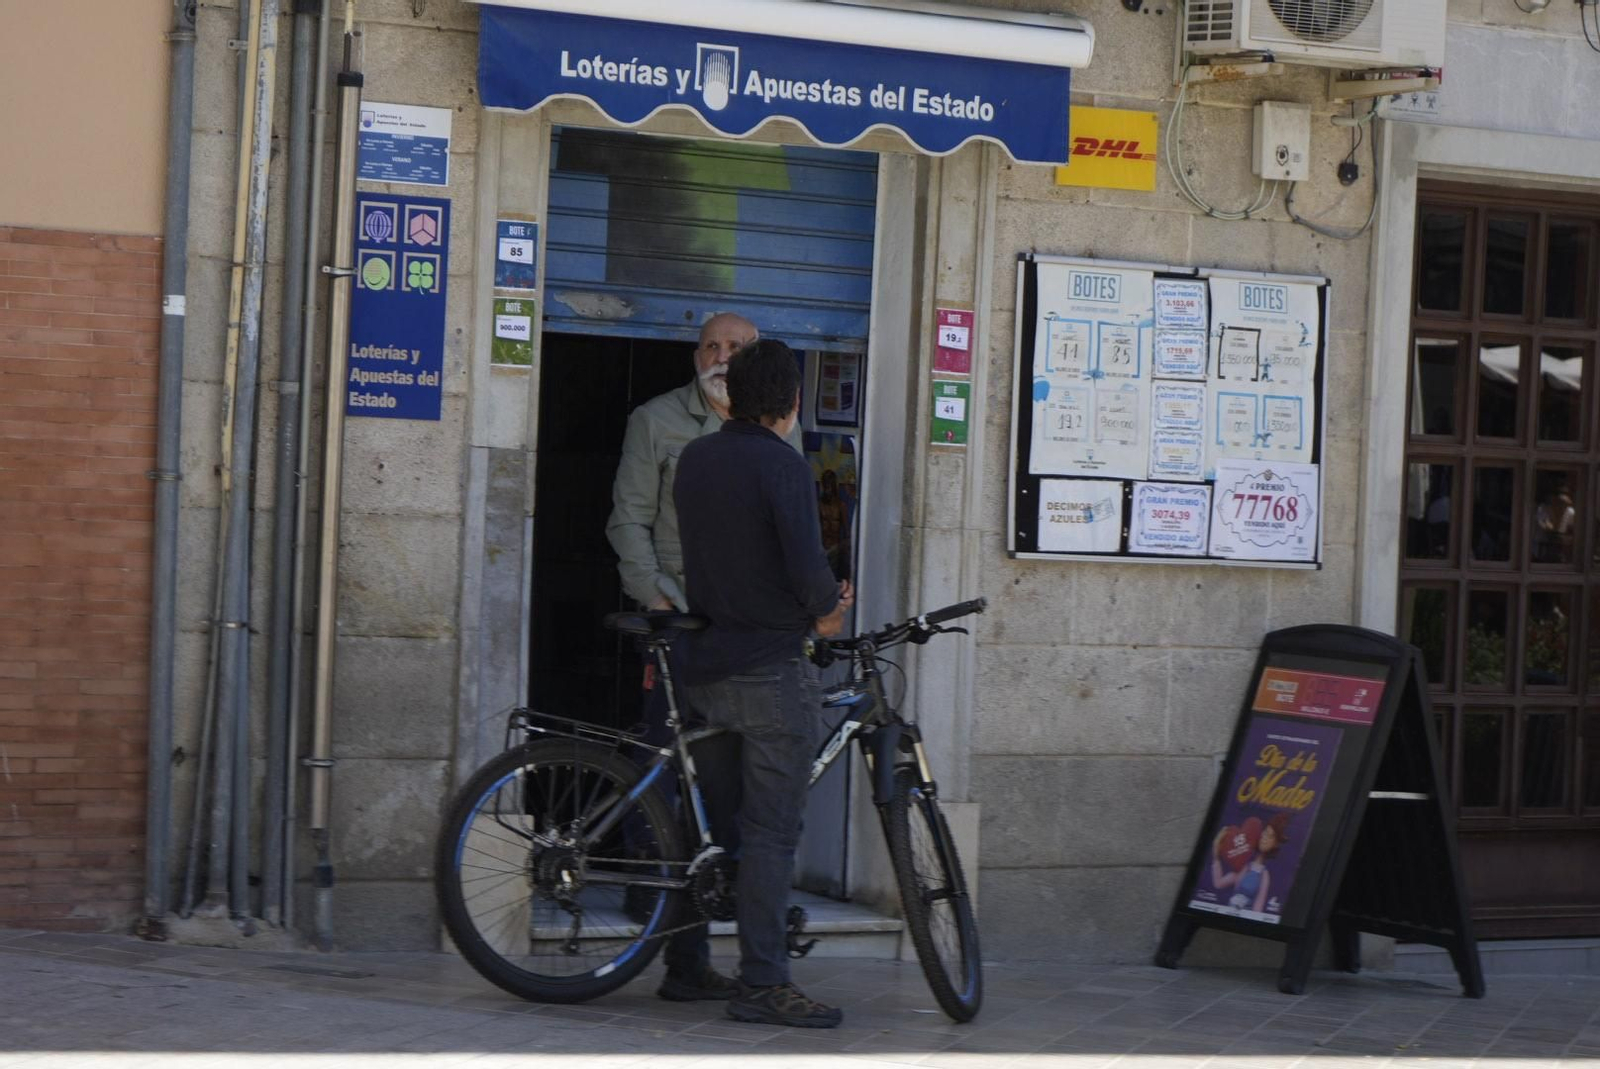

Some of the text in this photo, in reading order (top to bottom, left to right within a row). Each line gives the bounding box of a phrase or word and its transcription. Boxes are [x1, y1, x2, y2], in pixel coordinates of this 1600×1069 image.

[560, 50, 994, 122] Loterías y Apuestas del Estado
[1072, 137, 1143, 159] DHL
[509, 225, 525, 236] BOTE
[510, 247, 523, 257] 85
[1074, 275, 1116, 299] BOTES
[1244, 286, 1284, 310] BOTES
[351, 343, 420, 365] Loterías y
[350, 367, 439, 387] Apuestas del
[349, 391, 397, 409] Estado
[1255, 483, 1285, 491] PREMIO
[1146, 496, 1200, 506] GRAN PREMIO
[1232, 493, 1298, 522] 77768
[1144, 534, 1178, 542] VENDIDO
[1236, 769, 1316, 810] Madre
